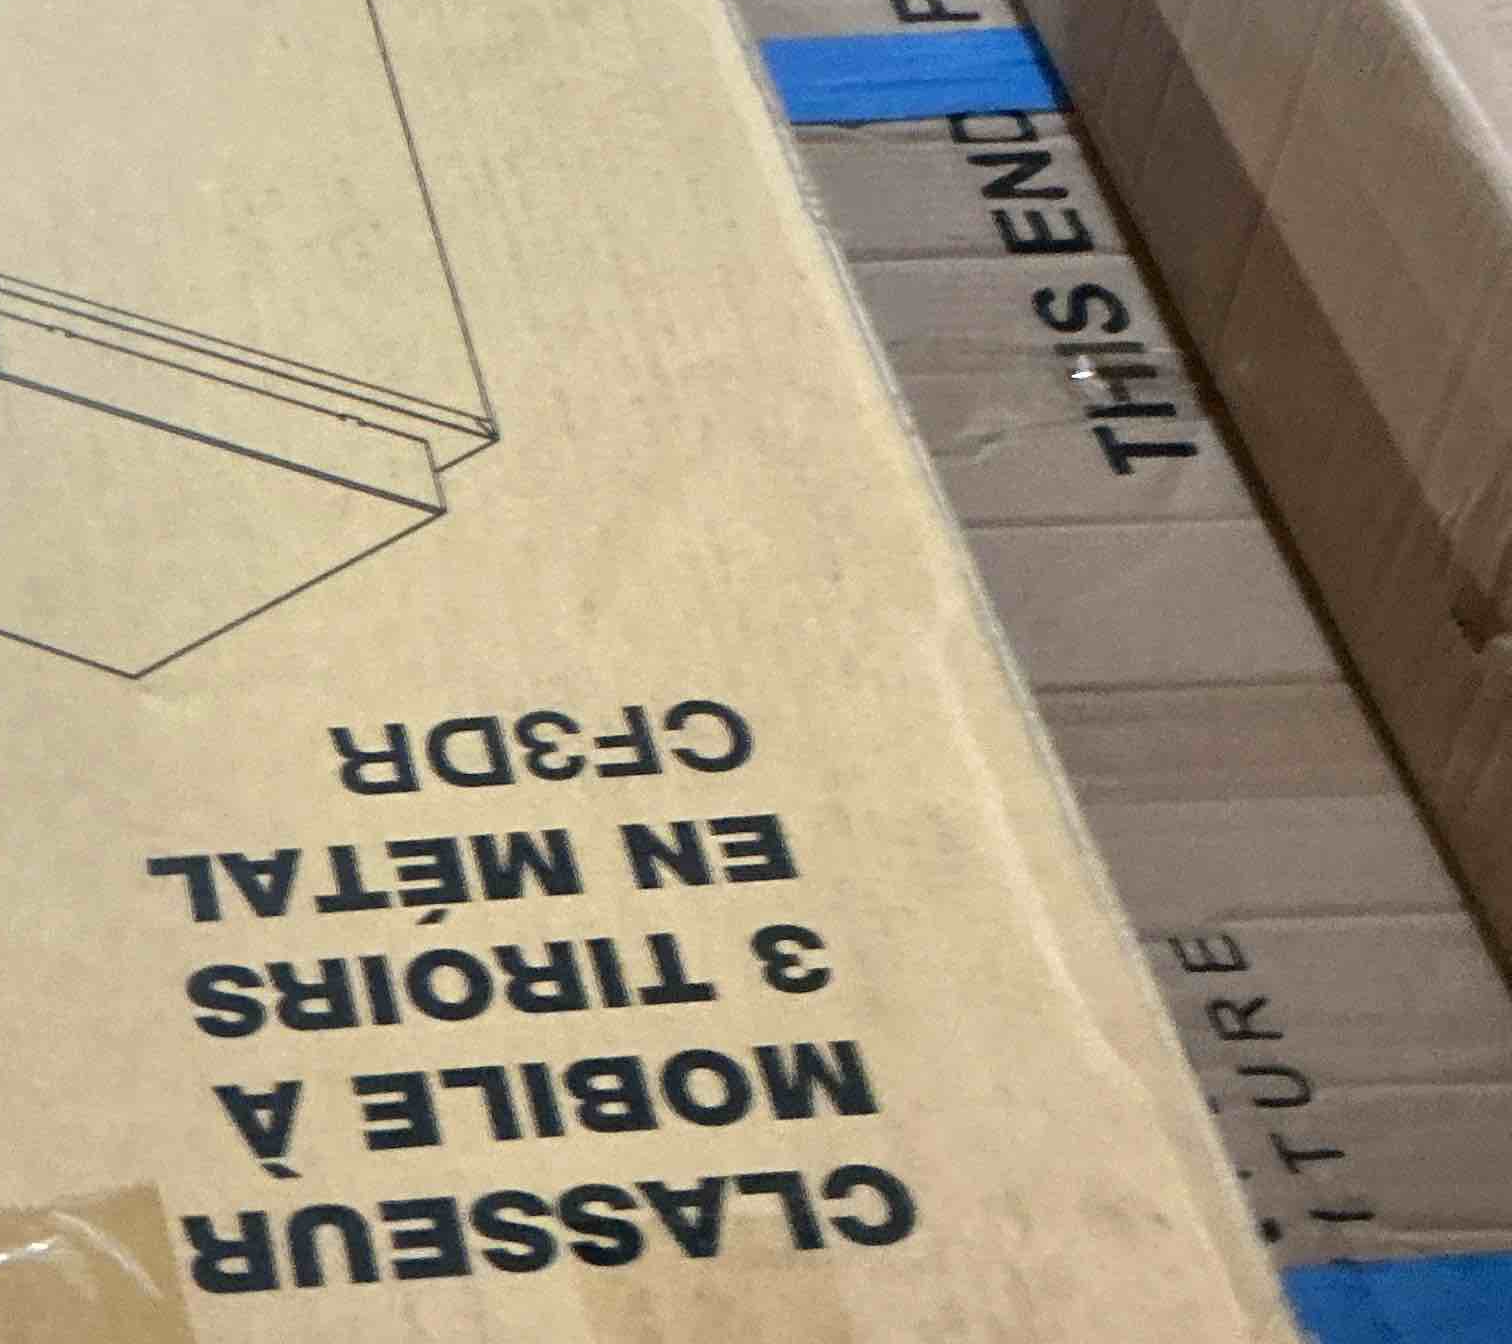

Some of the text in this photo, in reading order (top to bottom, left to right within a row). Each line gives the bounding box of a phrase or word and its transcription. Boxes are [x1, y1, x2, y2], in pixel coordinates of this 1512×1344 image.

[1029, 281, 1200, 476] THIS
[327, 698, 753, 797] CF3DR
[146, 813, 798, 926] EN MÉTAL
[186, 924, 831, 1038] 3 TIROIRS
[212, 1040, 880, 1177] MOBILE À
[180, 1163, 917, 1296] CLASSEUR
